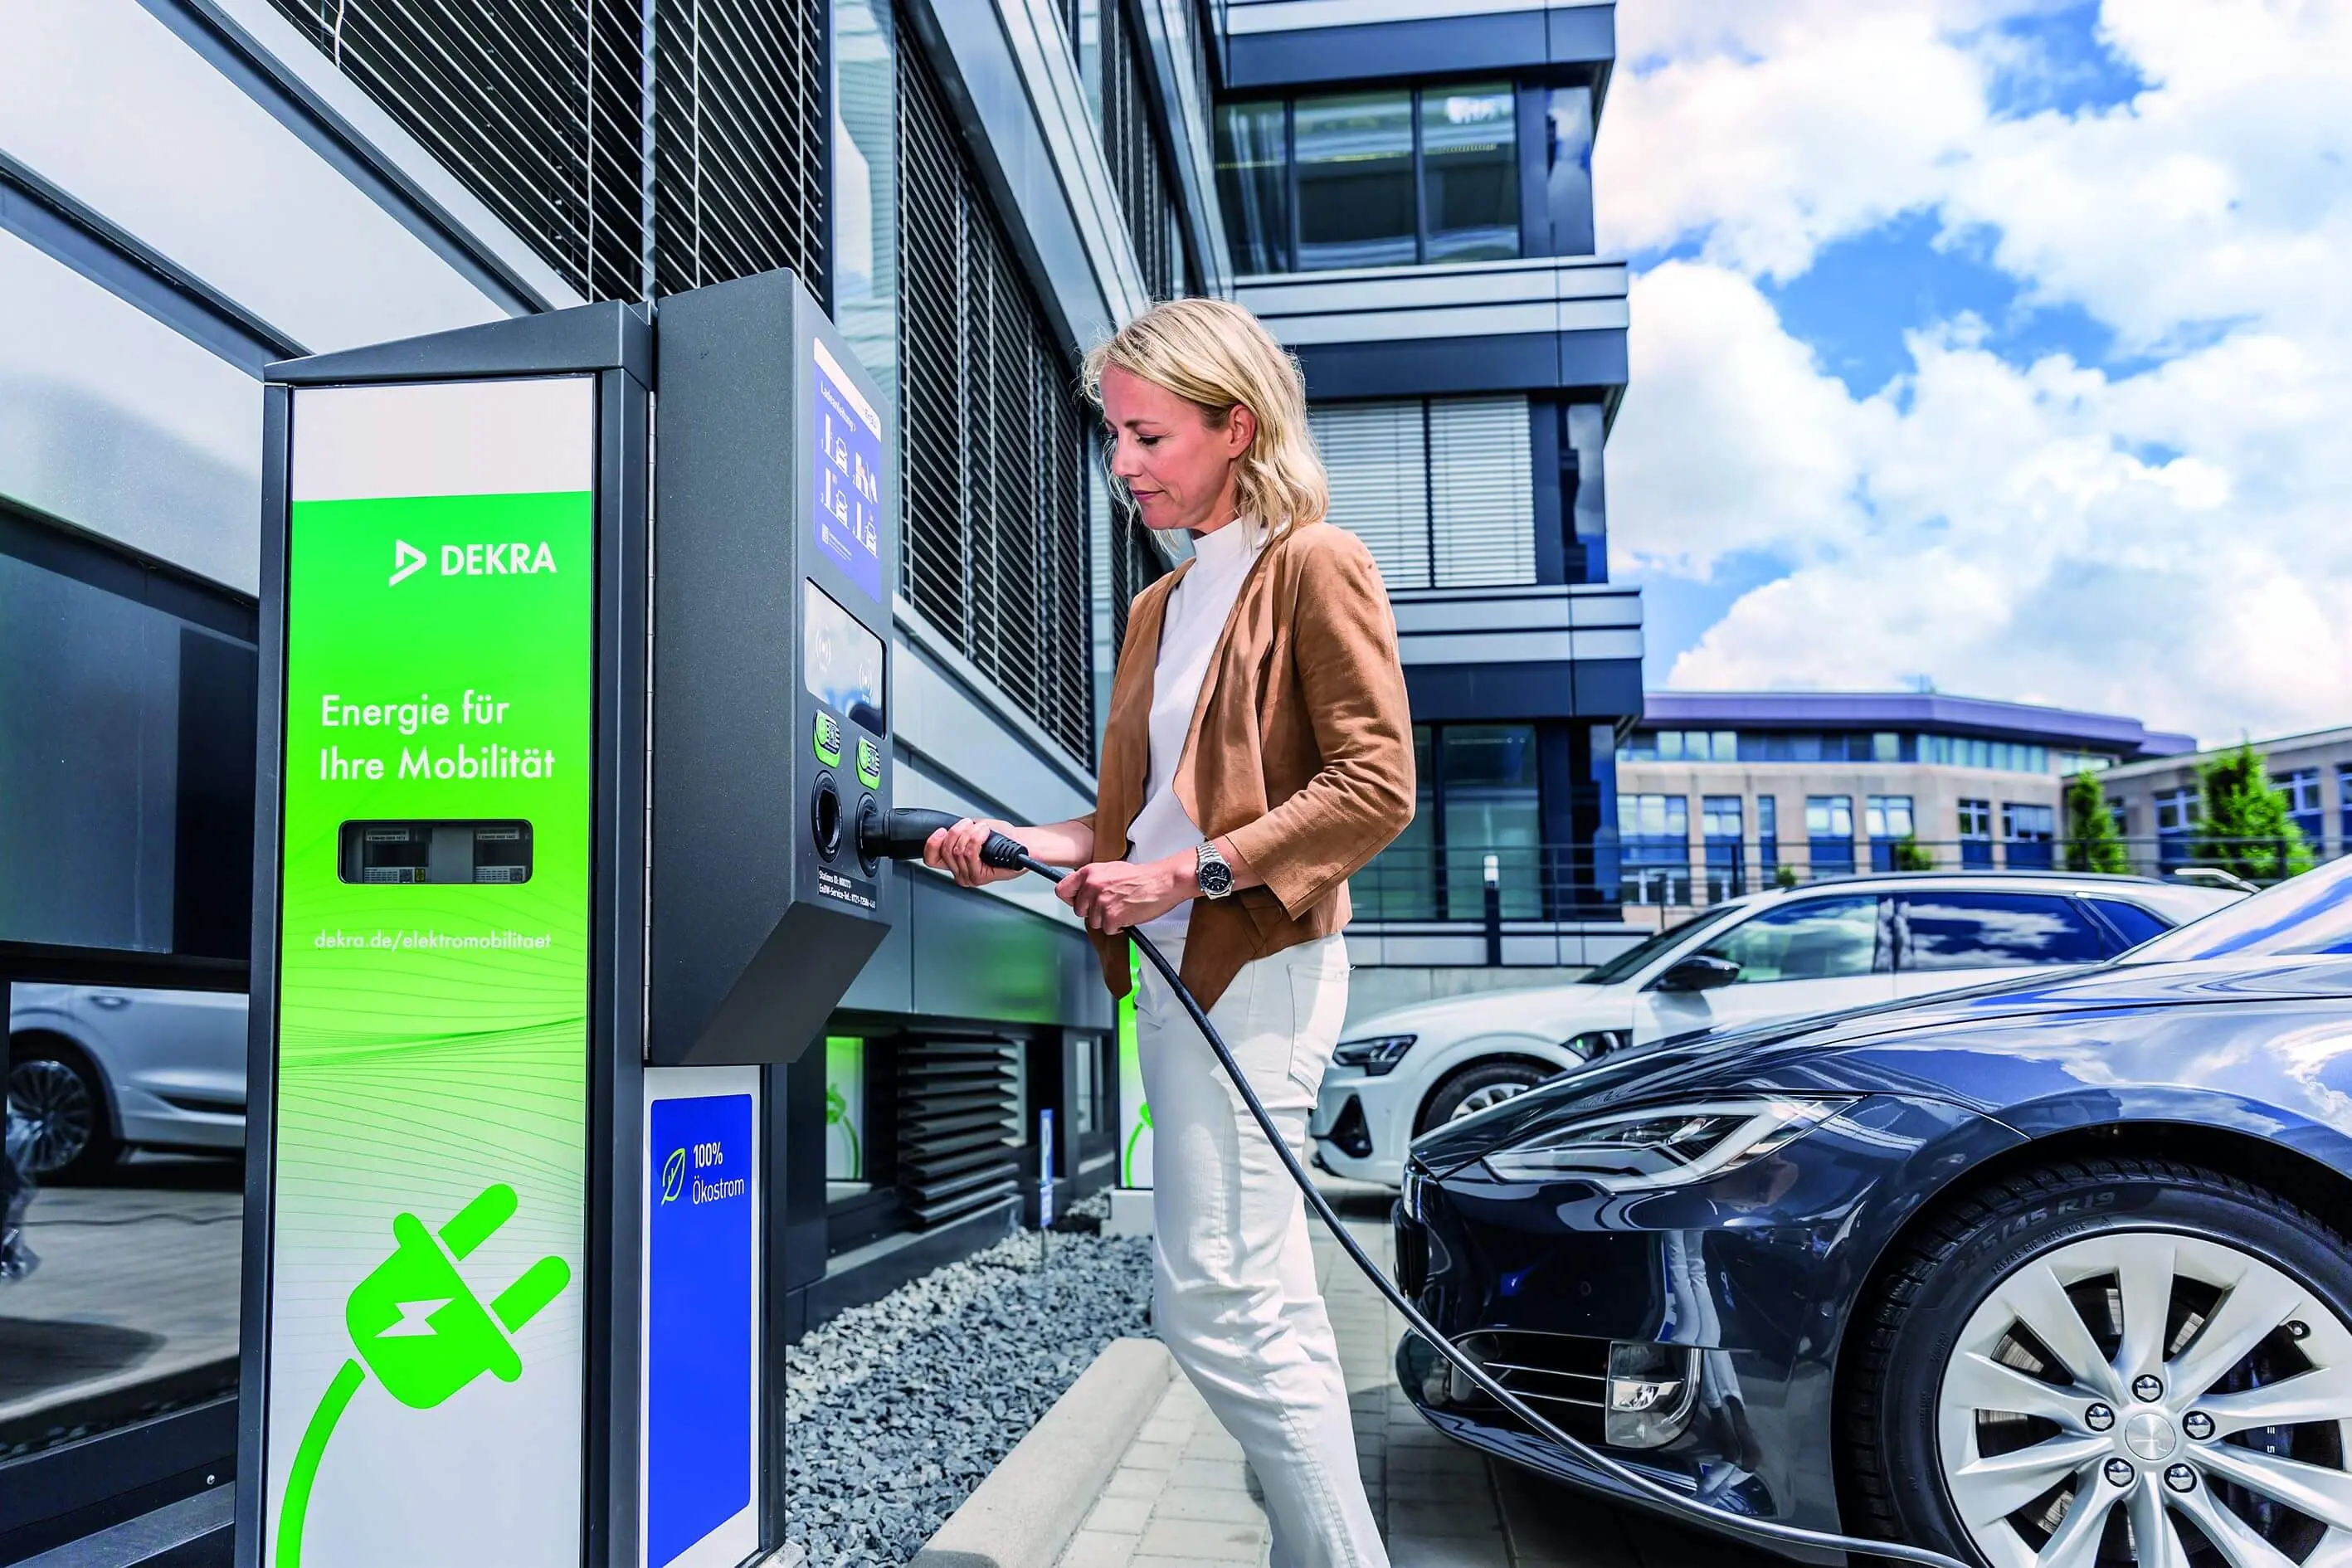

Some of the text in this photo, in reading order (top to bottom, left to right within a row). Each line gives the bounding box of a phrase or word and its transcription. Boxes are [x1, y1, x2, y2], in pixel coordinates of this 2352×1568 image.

[440, 542, 558, 576] DEKRA
[321, 689, 510, 735] Energie für
[320, 743, 555, 780] Ihre Mobilität
[314, 930, 552, 951] dekra.de/elektromobilitaet
[693, 1141, 723, 1169] 100%
[692, 1176, 745, 1205] Ökostrom
[2057, 1191, 2116, 1216] R19
